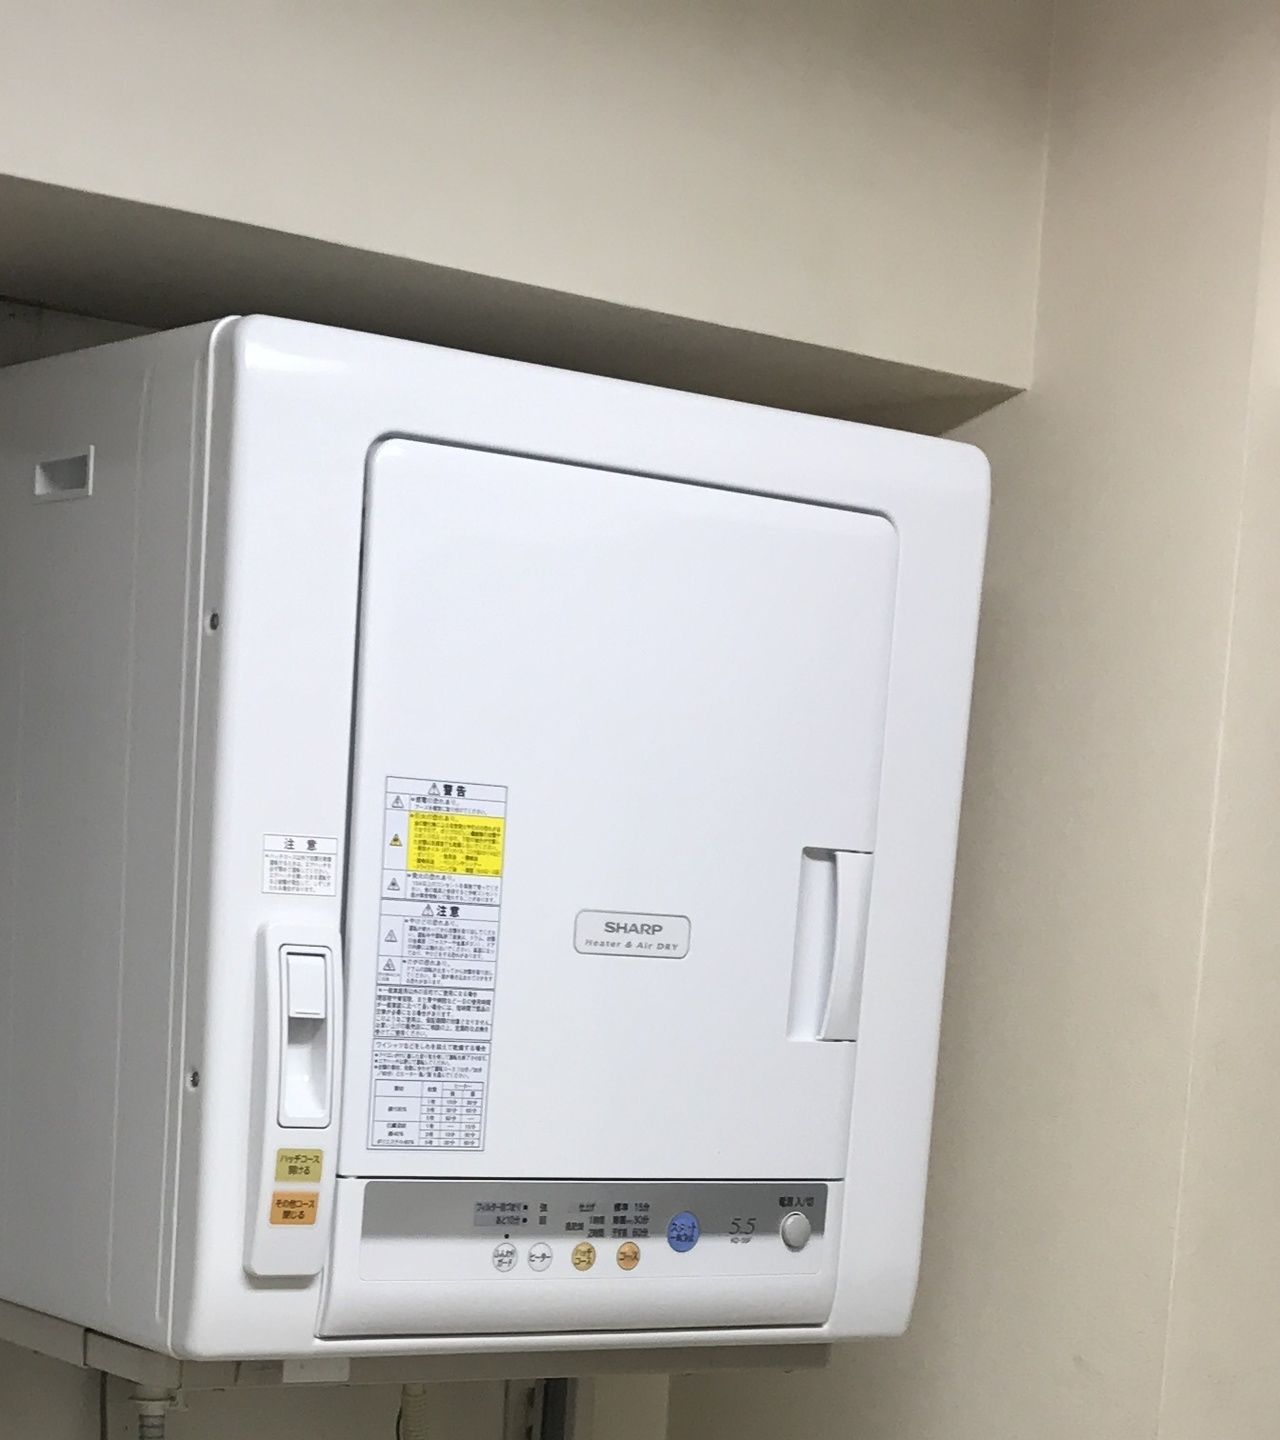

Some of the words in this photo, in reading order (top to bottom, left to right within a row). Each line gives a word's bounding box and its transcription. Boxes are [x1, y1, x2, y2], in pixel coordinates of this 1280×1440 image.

[443, 784, 467, 797] 警告
[283, 838, 318, 851] 注意
[436, 905, 460, 917] 注意
[604, 921, 663, 936] SHARP
[585, 938, 621, 949] Heater
[625, 940, 633, 949] &
[636, 941, 653, 950] Air
[656, 943, 679, 951] DRY
[280, 1155, 320, 1163] ハッチコース
[275, 1199, 315, 1208] その他コース
[529, 1253, 551, 1262] ヒーター
[620, 1251, 639, 1261] コース
